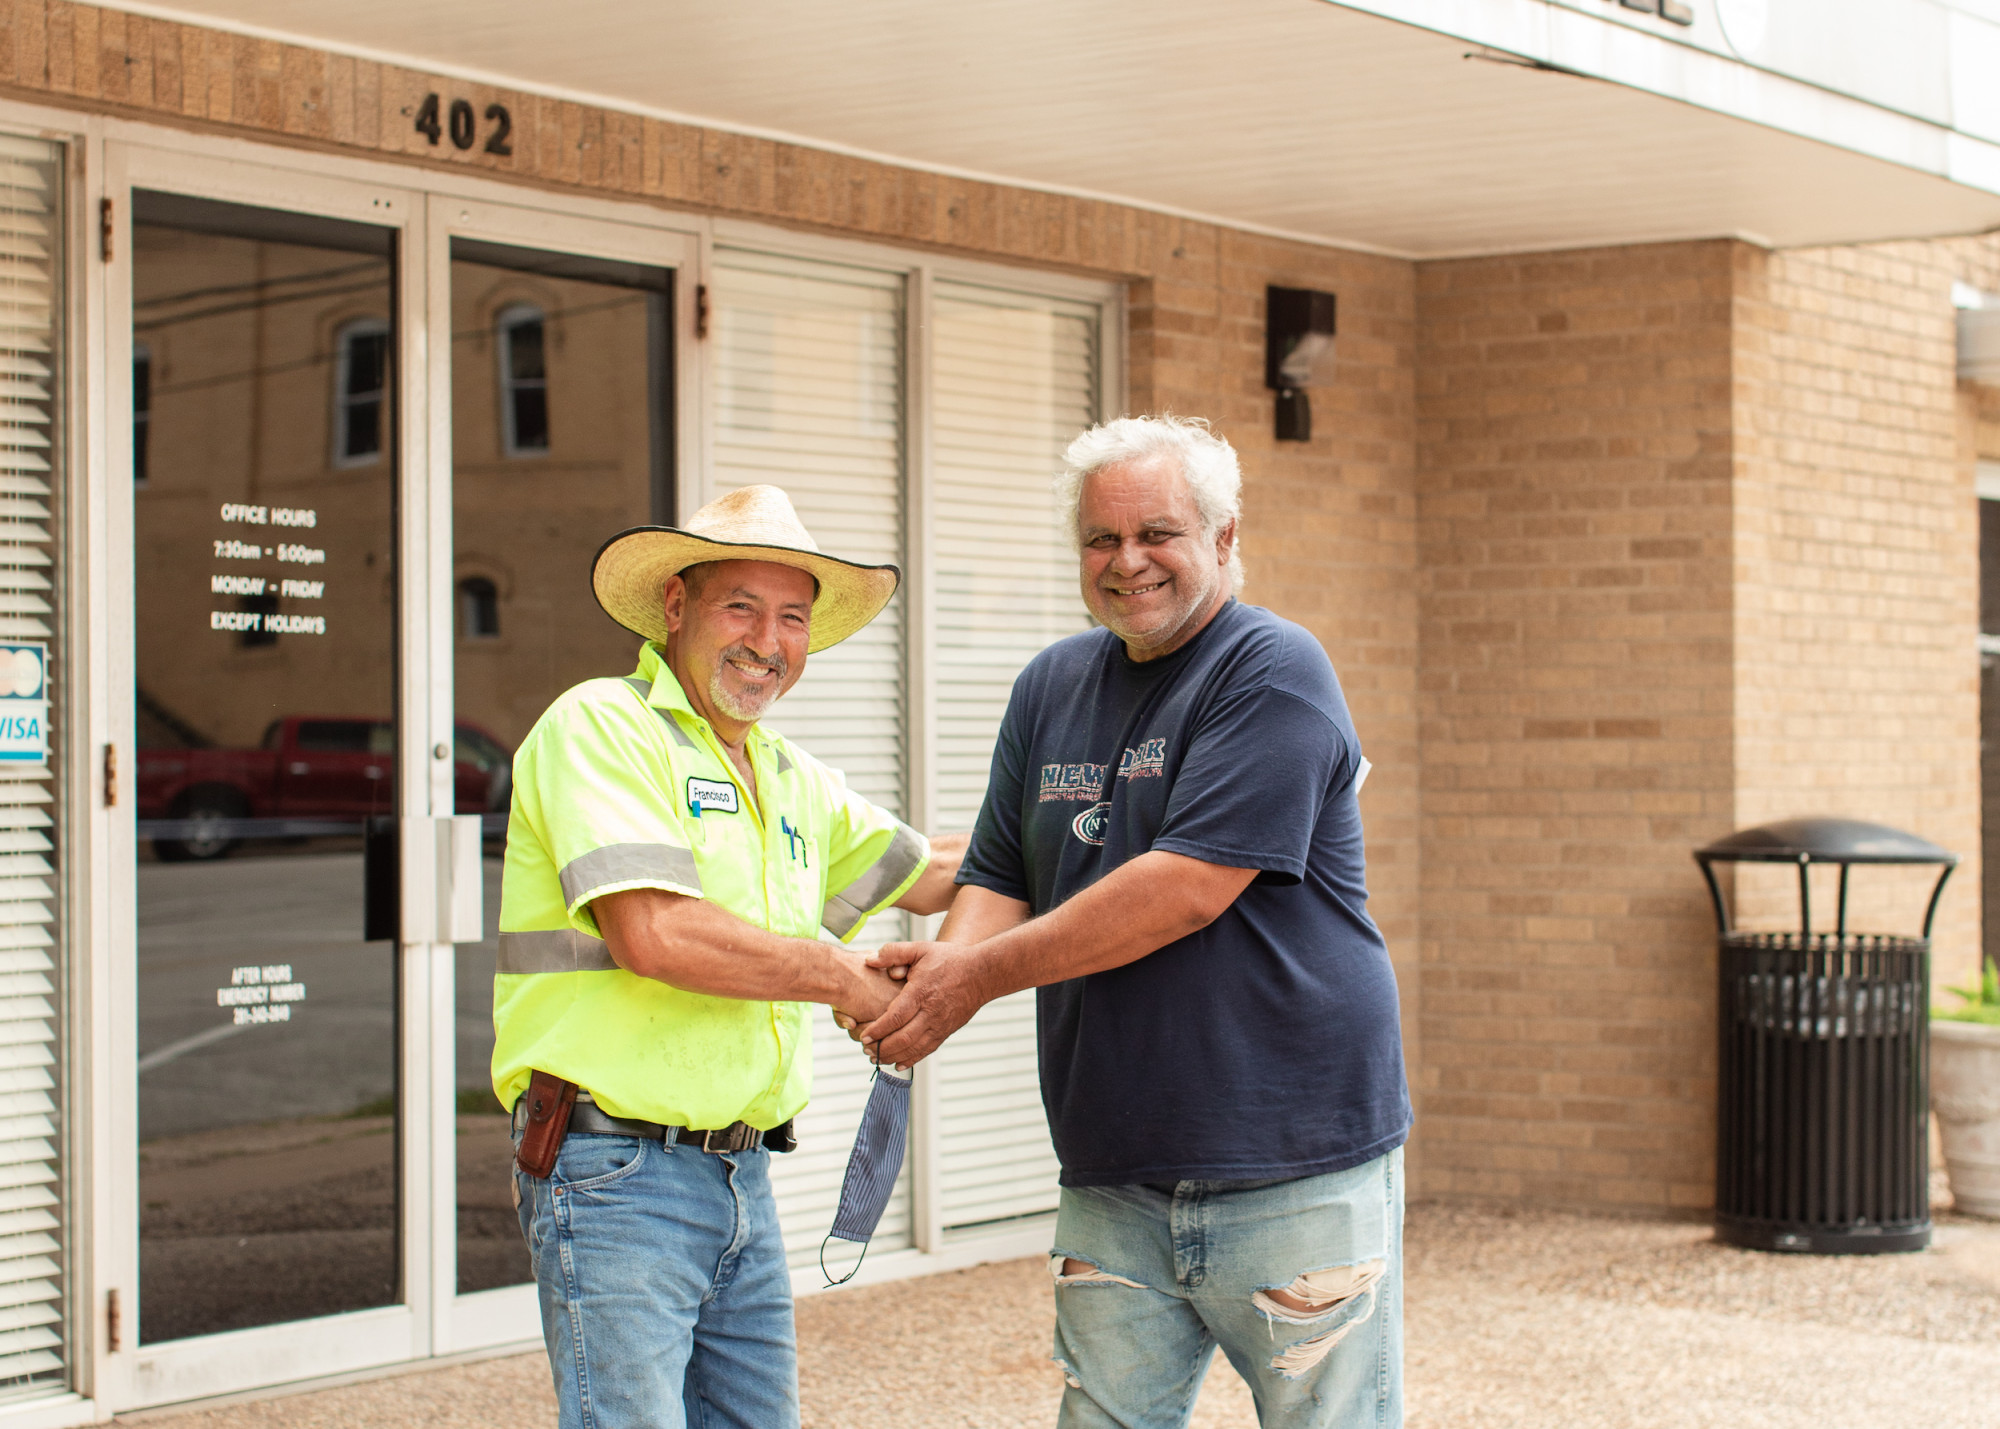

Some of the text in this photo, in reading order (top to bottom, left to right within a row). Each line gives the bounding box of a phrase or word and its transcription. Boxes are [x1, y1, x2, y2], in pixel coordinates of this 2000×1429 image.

[415, 93, 512, 156] 402
[221, 503, 317, 528] OFFICE HOURS
[213, 540, 326, 566] 7:30am - 5:00pm
[211, 575, 325, 599] MONDAY - FRIDAY
[210, 611, 326, 635] EXCEPT HOLIDAYS
[1041, 763, 1109, 788] NEW
[693, 787, 730, 803] Francisco
[231, 964, 293, 986] AFTER HOURS
[217, 983, 306, 1007] EMERGENCY NUMBER
